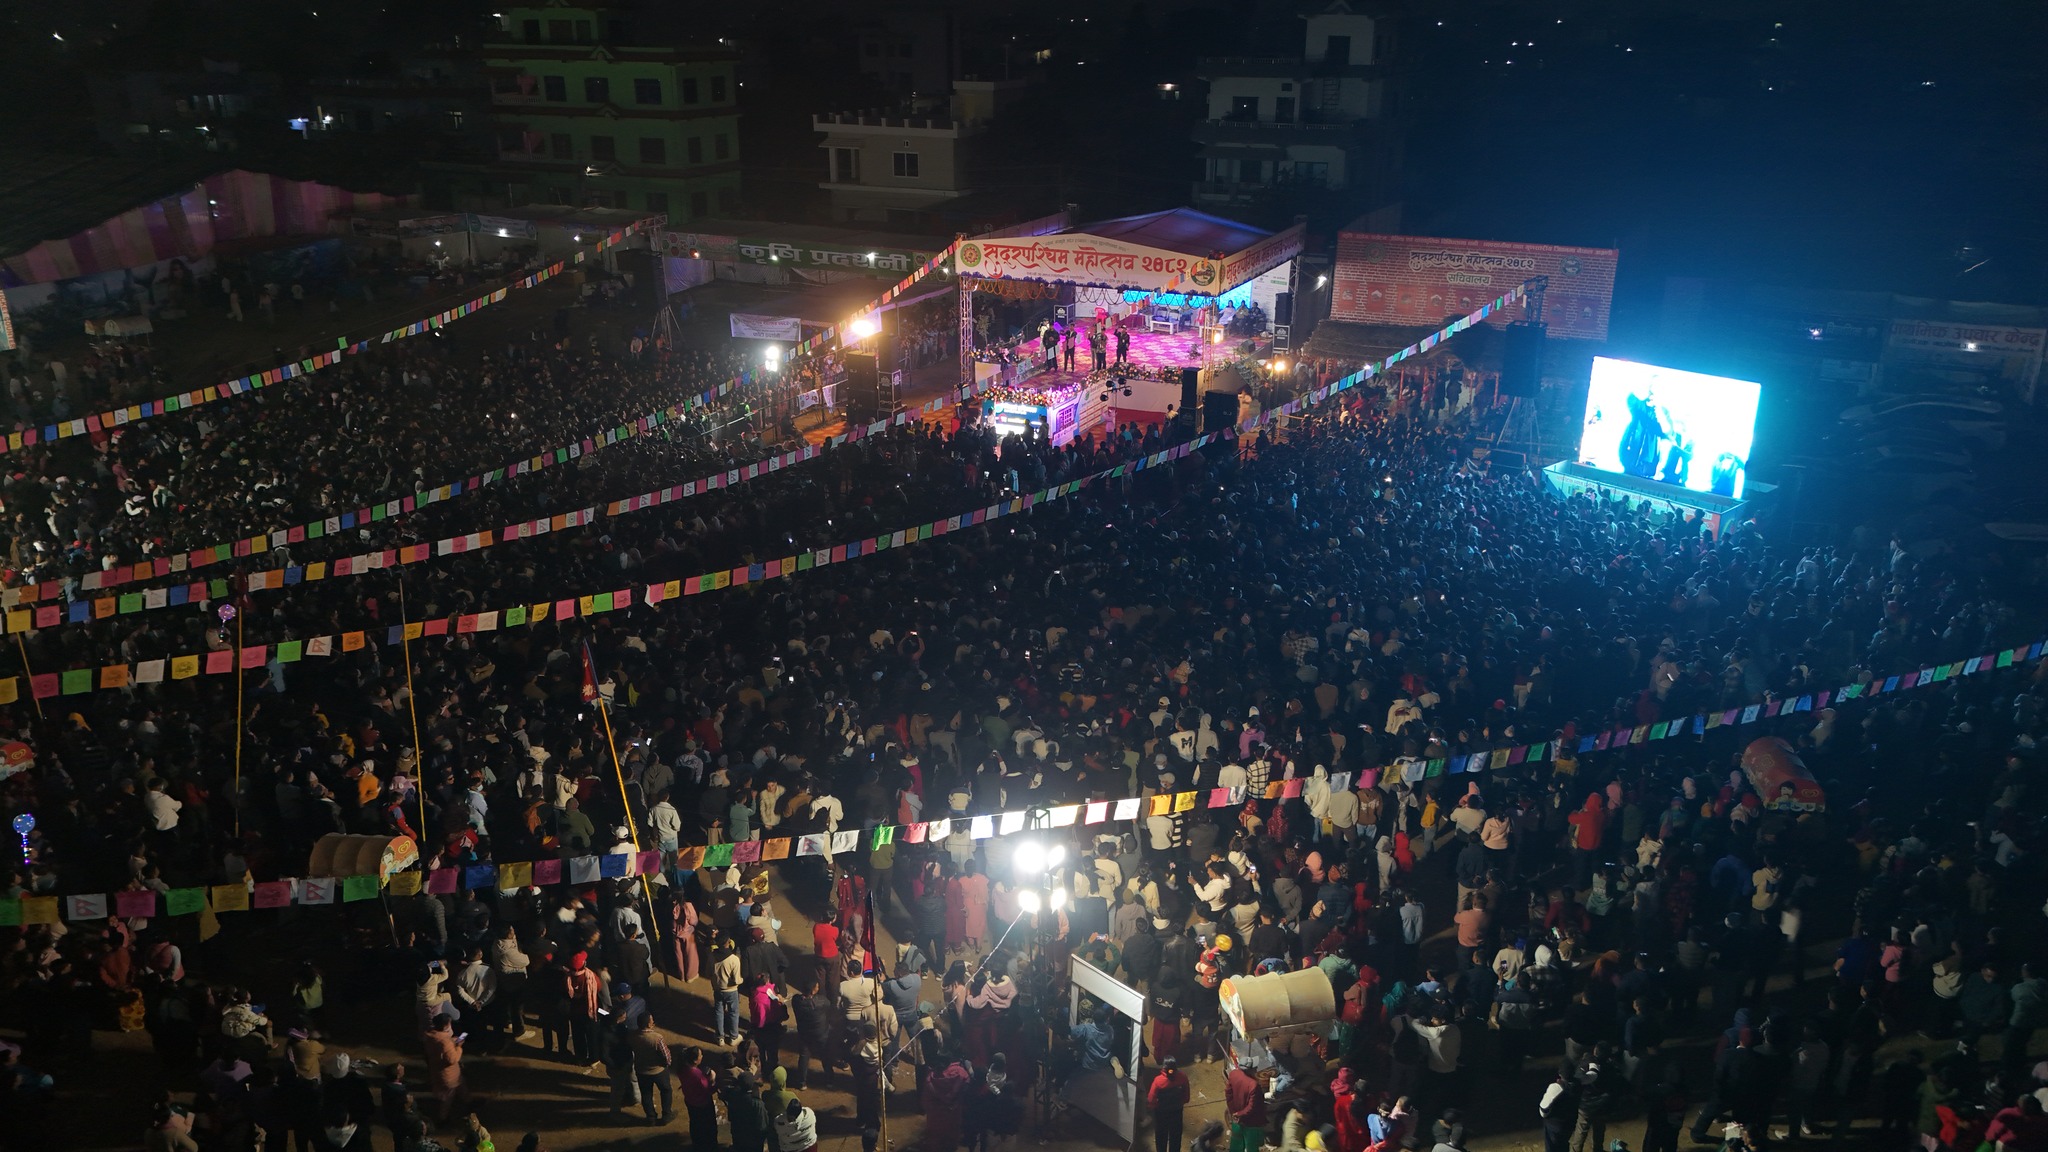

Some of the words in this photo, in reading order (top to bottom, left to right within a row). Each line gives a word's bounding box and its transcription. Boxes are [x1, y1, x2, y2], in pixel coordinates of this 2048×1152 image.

[740, 243, 803, 265] कृषि
[1073, 246, 1139, 278] महोत्सव
[1465, 252, 1505, 271] महोत्सव
[1448, 272, 1490, 285] सचिवालय
[1181, 736, 1193, 749] M
